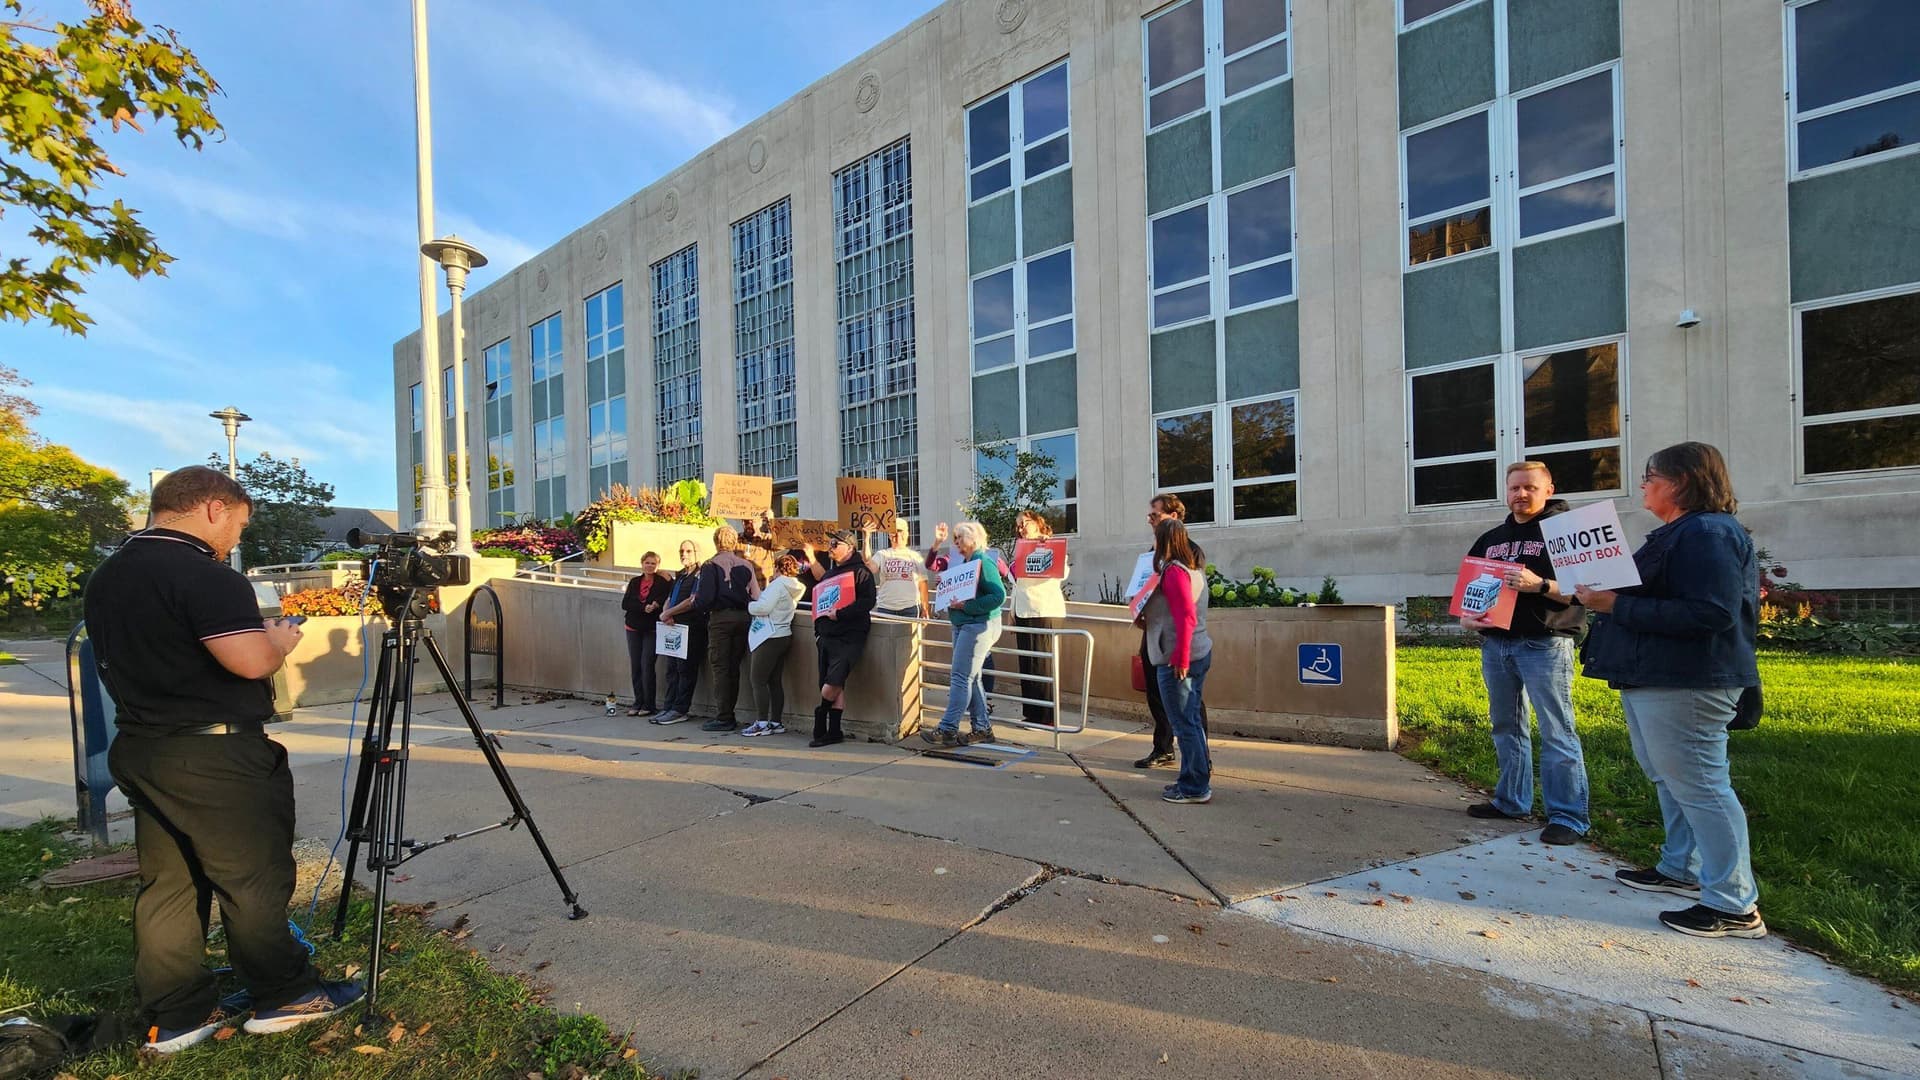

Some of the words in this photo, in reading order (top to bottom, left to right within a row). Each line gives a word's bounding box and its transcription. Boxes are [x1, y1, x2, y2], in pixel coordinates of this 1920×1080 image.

[841, 484, 887, 504] Where's
[860, 504, 872, 512] the
[851, 509, 894, 530] BOX?
[1548, 537, 1567, 555] OUR
[1567, 524, 1617, 550] VOTE
[1563, 551, 1592, 566] BALLOT
[1595, 545, 1622, 560] BOX
[939, 578, 952, 590] OUR
[954, 570, 975, 583] VOTE
[1466, 586, 1486, 598] OUR
[1463, 597, 1482, 610] VOTE
